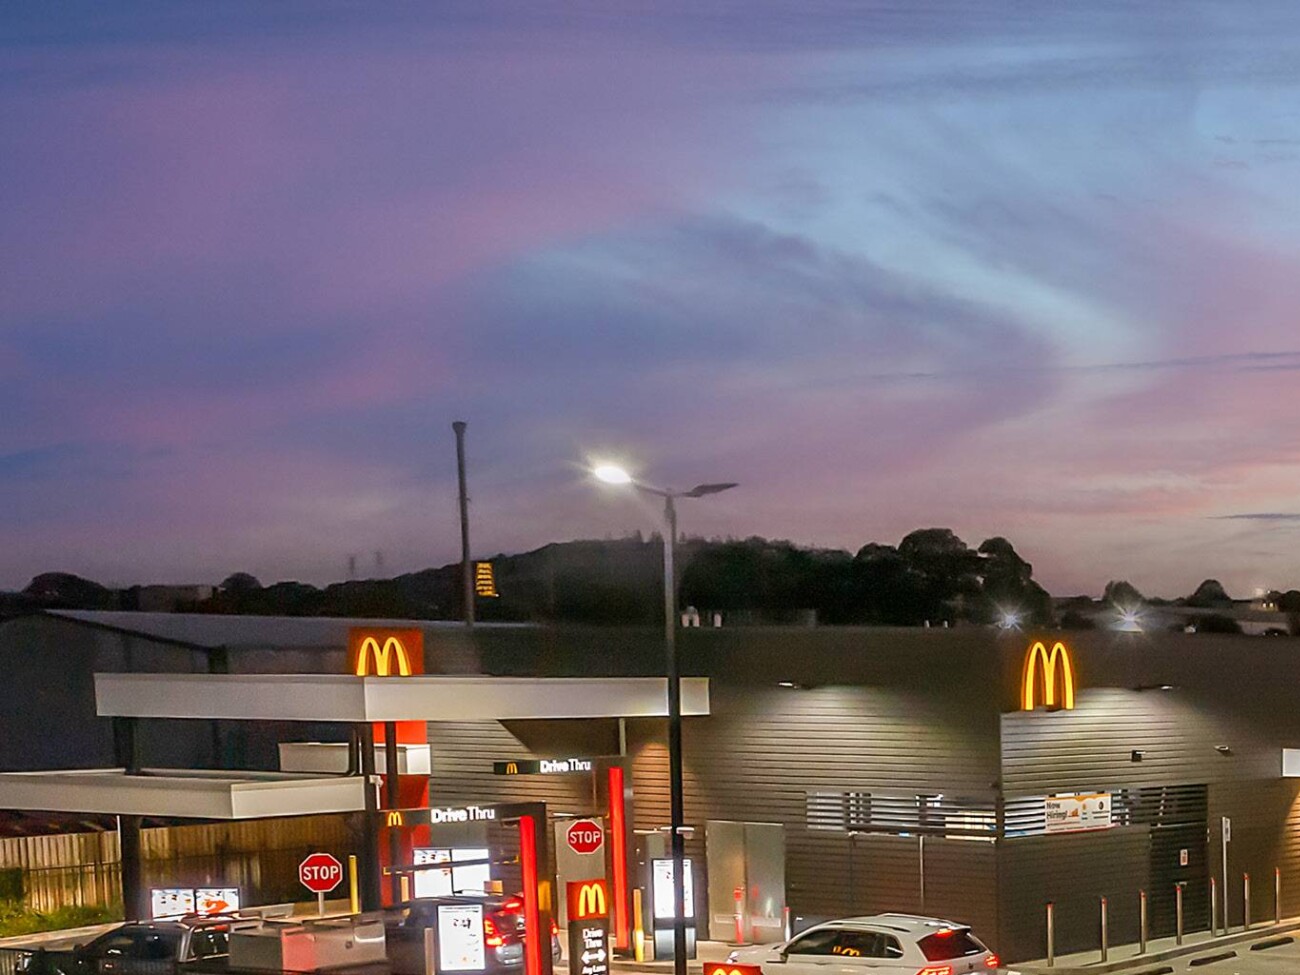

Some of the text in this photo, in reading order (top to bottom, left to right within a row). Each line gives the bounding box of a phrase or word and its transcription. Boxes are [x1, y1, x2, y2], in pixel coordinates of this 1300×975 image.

[540, 759, 591, 772] Drive Thru
[431, 807, 495, 823] Drive Thru
[569, 831, 601, 844] STOP
[303, 865, 339, 880] STOP
